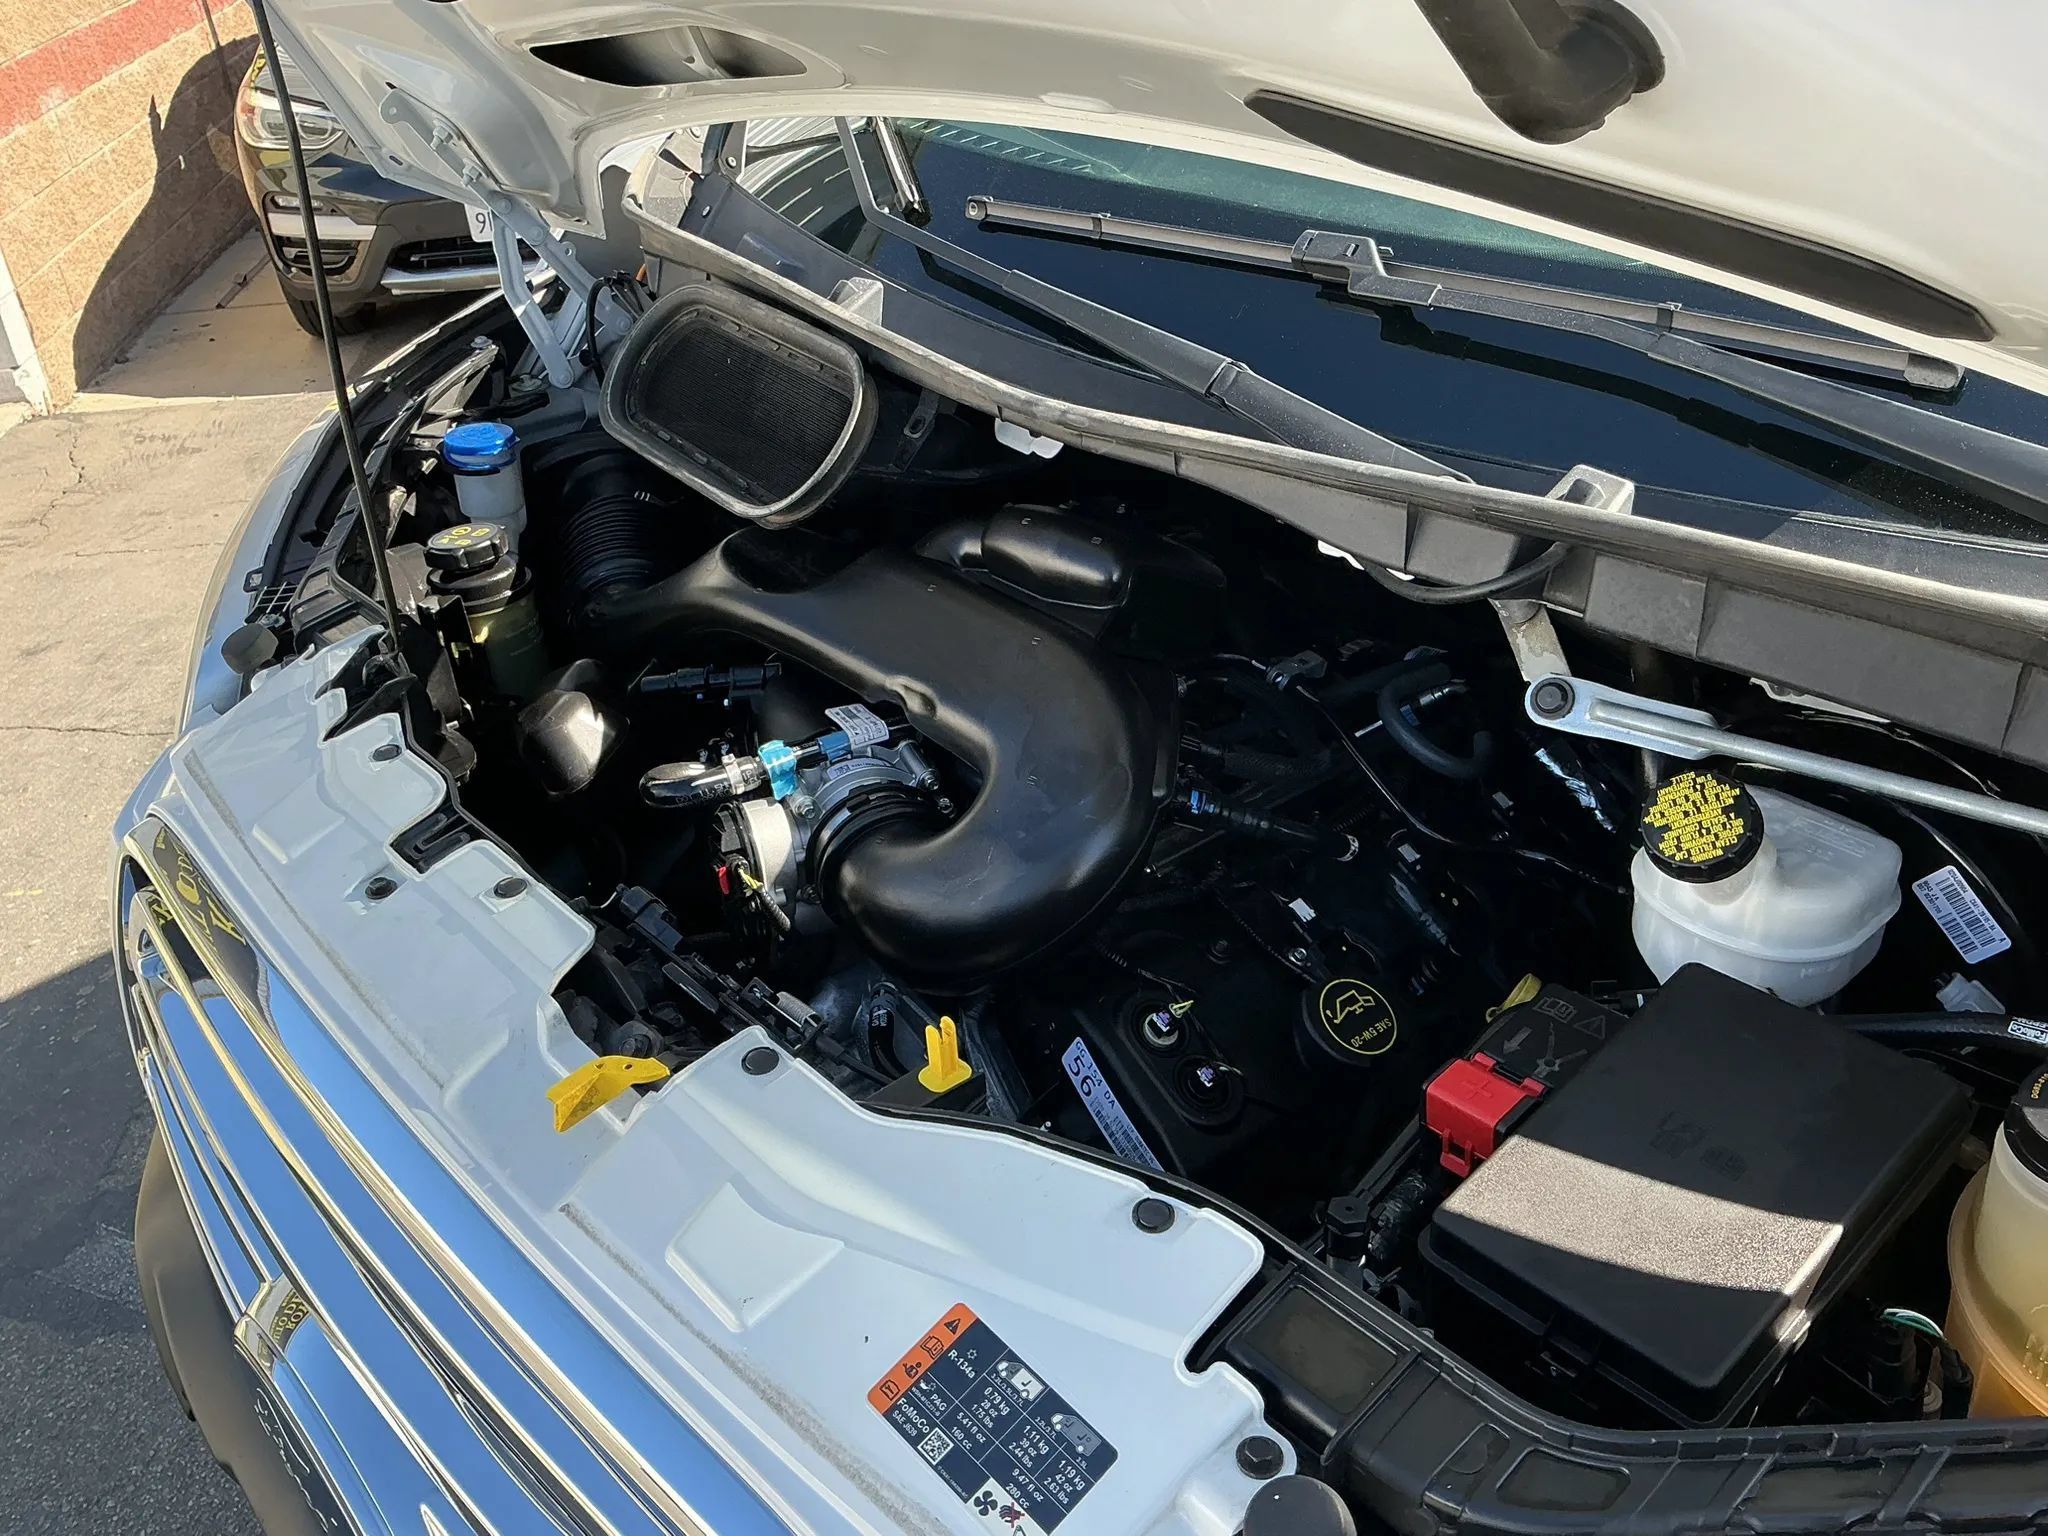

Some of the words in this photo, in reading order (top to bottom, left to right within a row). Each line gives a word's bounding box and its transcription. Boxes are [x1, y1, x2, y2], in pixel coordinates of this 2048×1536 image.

[1657, 779, 1693, 796] CONTENANT
[1703, 783, 1729, 796] PLOYER
[1704, 779, 1717, 788] DOT
[1656, 787, 1693, 803] PROVENANT
[1676, 796, 1684, 805] DU
[1687, 791, 1701, 801] QUE
[1695, 798, 1704, 806] LE
[1706, 794, 1715, 802] DE
[1718, 788, 1740, 800] AVANT
[1648, 800, 1672, 813] LIQUIDE
[1699, 797, 1733, 812] NETTOYER
[1653, 812, 1683, 827] BOUCHON
[1701, 814, 1727, 827] SEALED
[1726, 818, 1743, 828] ONLY
[1679, 830, 1699, 842] FLUID
[1709, 824, 1722, 833] DOT
[1718, 826, 1743, 839] BEFORE
[1658, 838, 1676, 849] FROM
[1689, 843, 1711, 855] FILLER
[1715, 836, 1737, 847] CLEAN
[1662, 846, 1676, 856] USE
[1674, 851, 1688, 860] CAP
[1374, 1018, 1392, 1033] SAE
[2010, 1024, 2045, 1040] FoMoCo
[1350, 1027, 1377, 1048] 5W-20
[1068, 1055, 1099, 1097] 56
[1075, 1040, 1087, 1058] GG
[1086, 1062, 1103, 1087] 154
[1103, 1090, 1116, 1109] DA
[948, 1349, 976, 1379] R-134a
[930, 1393, 947, 1411] PAG
[980, 1399, 991, 1410] 28
[988, 1408, 998, 1418] oz
[984, 1386, 1002, 1404] 0.79
[998, 1400, 1010, 1416] kg
[892, 1410, 906, 1424] SAE
[902, 1422, 918, 1437] J639
[896, 1397, 930, 1434] FoMoCo
[971, 1404, 986, 1419] 1.75
[982, 1415, 994, 1428] lbs
[956, 1412, 972, 1428] 5.41
[970, 1426, 978, 1434] fl
[976, 1433, 986, 1444] oz
[951, 1426, 965, 1440] 160
[962, 1439, 972, 1450] cc
[1023, 1425, 1039, 1442] 1.11
[1037, 1439, 1050, 1455] kg
[1008, 1442, 1025, 1458] 2.44
[1021, 1454, 1033, 1468] lbs
[1019, 1437, 1030, 1448] 39
[1027, 1447, 1038, 1457] oz
[1055, 1474, 1066, 1484] 42
[1063, 1482, 1073, 1493] oz
[1058, 1460, 1076, 1478] 1.19
[1073, 1474, 1086, 1491] kg
[1012, 1468, 1029, 1485] 9.47
[1026, 1483, 1036, 1492] fl
[1033, 1491, 1044, 1502] oz
[1043, 1477, 1060, 1494] 2.63
[1057, 1490, 1069, 1504] lbs
[1005, 1482, 1021, 1499] 280
[1019, 1498, 1030, 1509] cc
